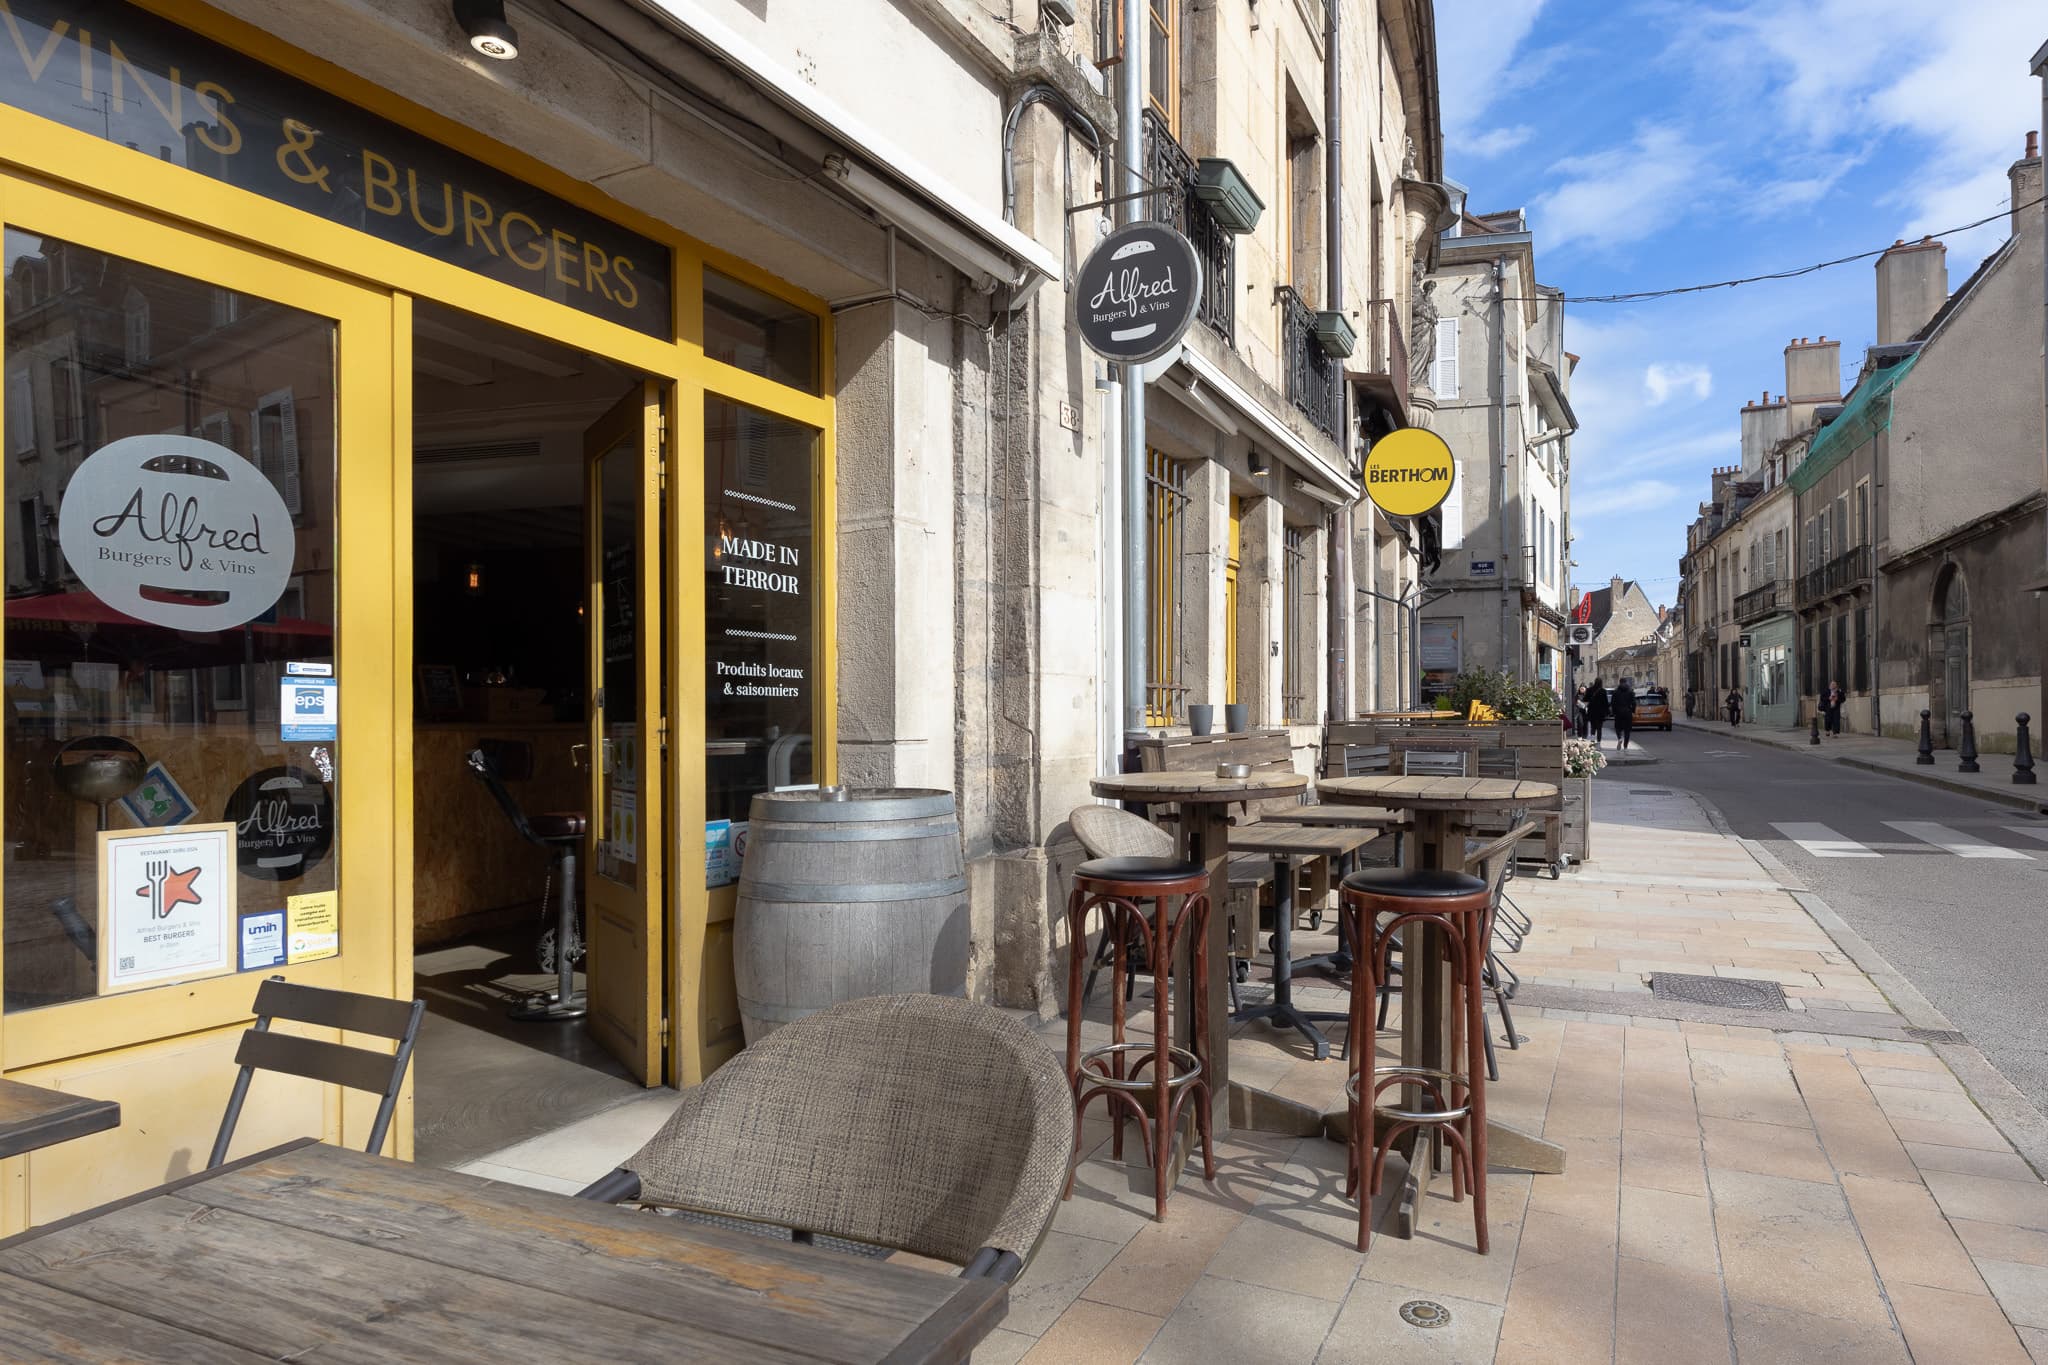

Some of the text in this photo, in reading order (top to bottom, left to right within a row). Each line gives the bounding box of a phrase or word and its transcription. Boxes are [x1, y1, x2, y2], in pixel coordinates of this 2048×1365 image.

[0, 0, 640, 310] VINS & BURGERS
[1090, 266, 1178, 318] Alfred
[1092, 300, 1170, 324] Burgers & Vins
[1063, 406, 1077, 427] 38
[1370, 467, 1448, 484] BERTHOM
[93, 487, 269, 571] Alfred
[98, 546, 256, 575] Burgers & Vins
[721, 536, 799, 566] MADE IN
[721, 565, 800, 595] TERROIR
[717, 661, 804, 679] Produits locaux
[724, 682, 799, 698] & saisonniers
[296, 695, 325, 709] eps
[237, 800, 322, 846] Alfred
[238, 837, 274, 850] Burgers
[297, 834, 316, 845] Vins
[144, 930, 195, 943] BEST BURGERS
[248, 922, 277, 935] umih
